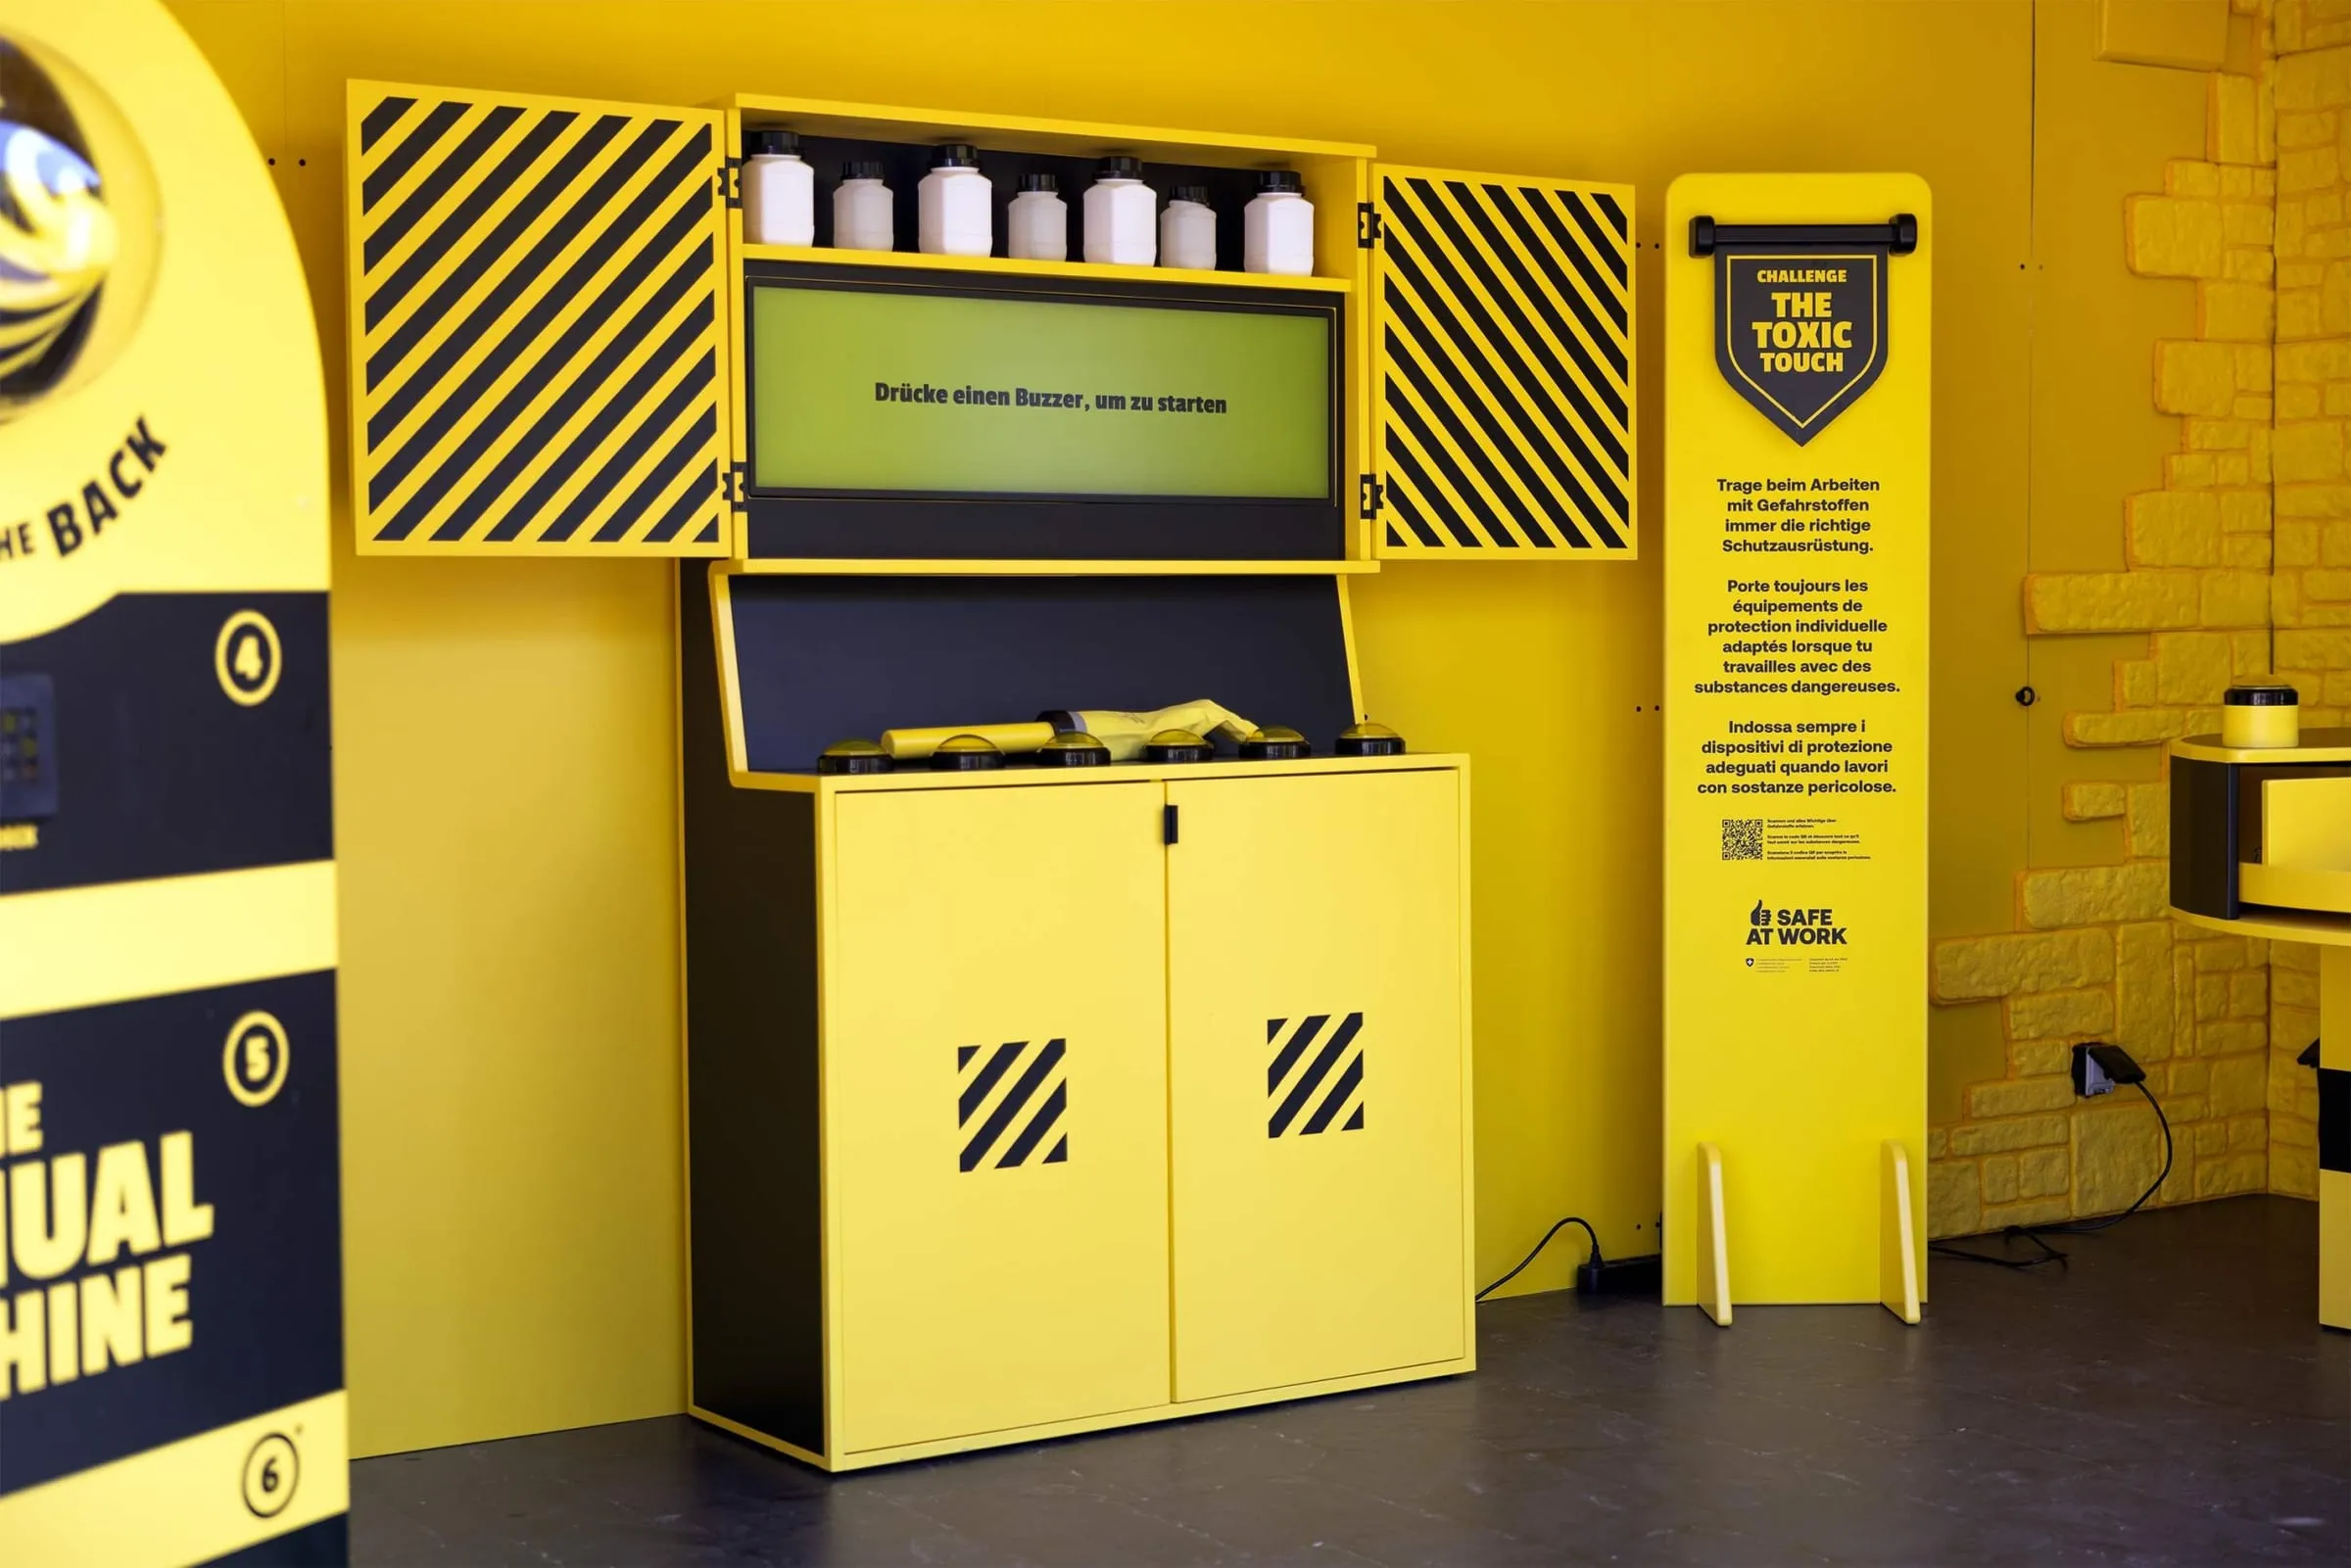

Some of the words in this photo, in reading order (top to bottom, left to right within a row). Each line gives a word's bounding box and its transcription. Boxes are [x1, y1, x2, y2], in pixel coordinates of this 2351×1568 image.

[1756, 269, 1847, 283] CHALLENGE
[1770, 292, 1833, 318] THE
[1751, 320, 1852, 350] TOXIC
[1759, 353, 1844, 373] TOUCH
[875, 382, 949, 404] Drücke
[952, 385, 1011, 406] einen
[1015, 387, 1090, 412] Buzzer,
[1095, 395, 1127, 410] um
[1129, 396, 1154, 411] zu
[1157, 395, 1227, 414] starten
[47, 414, 167, 557] BACK
[1716, 478, 1763, 496] Trage
[1766, 477, 1806, 492] beim
[1809, 477, 1880, 492] Arbeiten
[1727, 498, 1753, 512] mit
[1756, 498, 1870, 512] Gefahrstoffen
[1725, 518, 1778, 533] immer
[1780, 518, 1805, 532] die
[1809, 517, 1871, 535] richtige
[1722, 538, 1874, 555] Schutzausrüstung.
[1727, 579, 1770, 593] Porte
[1773, 578, 1842, 595] toujours
[1845, 579, 1869, 593] les
[1732, 598, 1839, 616] équipements
[1842, 598, 1863, 612] de
[1707, 619, 1792, 637] protection
[1796, 618, 1889, 633] individuelle
[234, 634, 264, 681] 4
[1722, 640, 1788, 656] adaptés
[1792, 640, 1852, 656] lorsque
[1855, 640, 1873, 652] tu
[1722, 659, 1797, 674] travailles
[1799, 662, 1839, 673] avec
[1842, 659, 1872, 673] des
[1694, 680, 1789, 693] substances
[1791, 680, 1900, 696] dangereuses.
[1729, 720, 1793, 734] Indossa
[1796, 722, 1857, 736] sempre
[1860, 719, 1866, 733] i
[1701, 739, 1785, 757] dispositivi
[1788, 739, 1803, 753] di
[1806, 738, 1894, 757] protezione
[1705, 759, 1776, 778] adeguati
[1779, 759, 1841, 777] quando
[1844, 759, 1889, 774] lavori
[1697, 784, 1728, 794] con
[1731, 781, 1804, 794] sostanze
[1807, 779, 1896, 797] pericolose.
[1777, 908, 1833, 927] SAFE
[1746, 927, 1774, 946] AT
[1777, 927, 1847, 945] WORK
[245, 1034, 270, 1082] 5
[262, 1455, 279, 1494] 6
